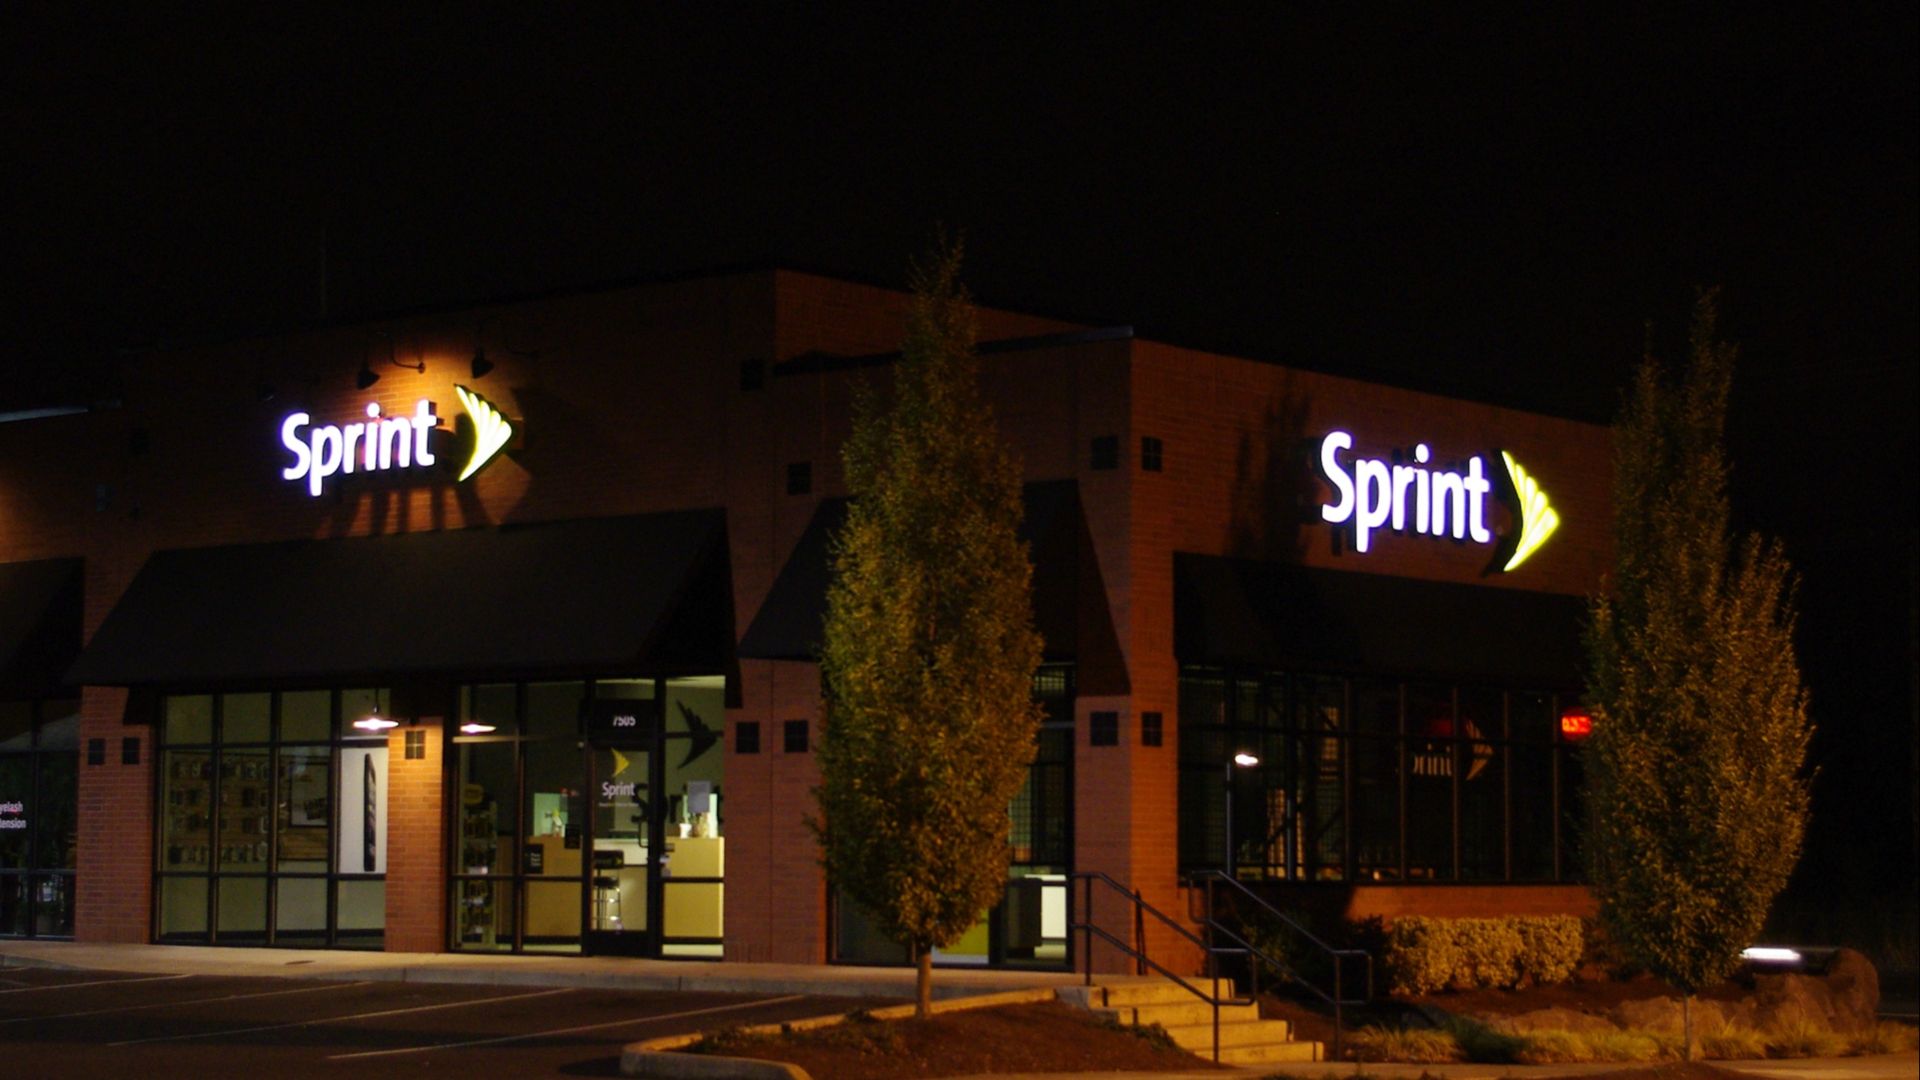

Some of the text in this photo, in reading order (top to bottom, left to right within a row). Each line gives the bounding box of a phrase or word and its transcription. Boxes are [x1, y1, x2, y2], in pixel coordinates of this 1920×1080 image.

[281, 399, 437, 497] Sprint
[1320, 430, 1491, 553] Sprint
[602, 782, 636, 800] Sprint
